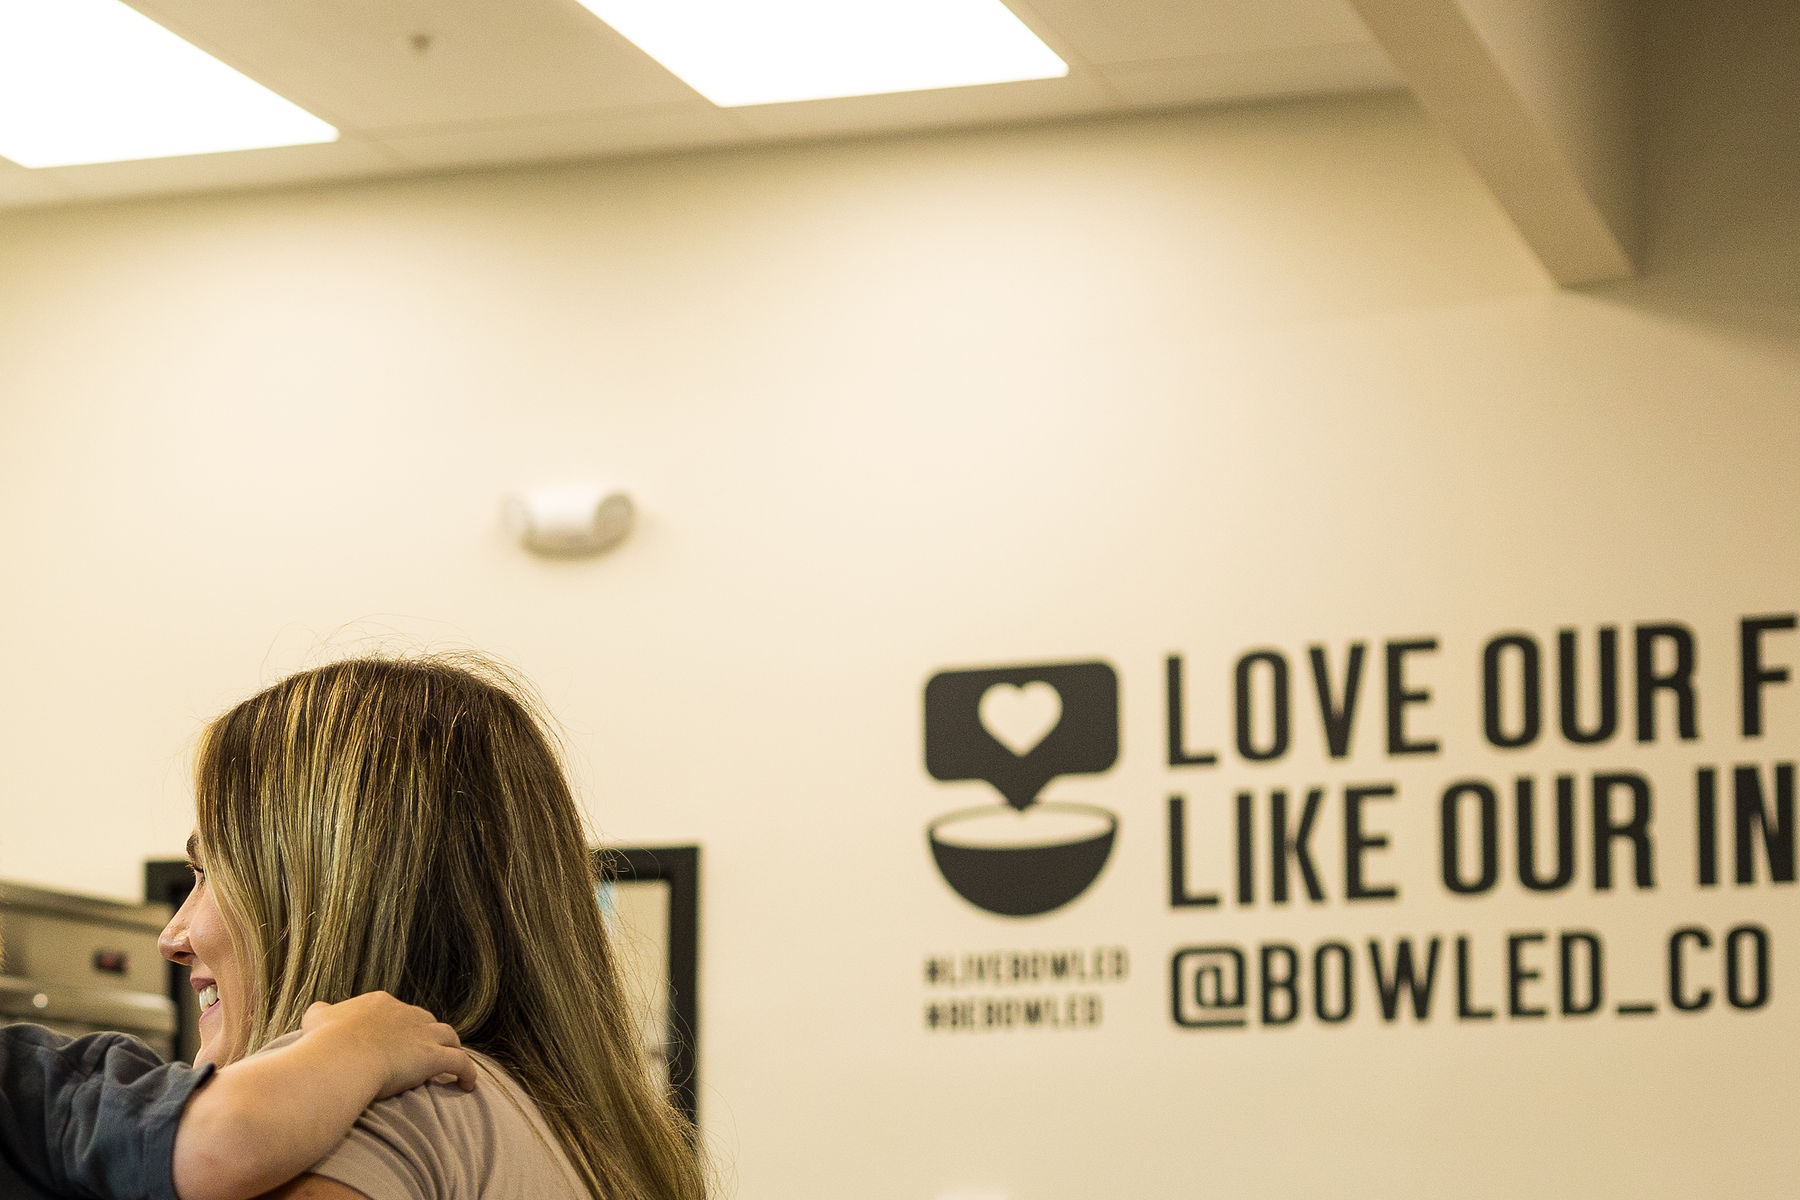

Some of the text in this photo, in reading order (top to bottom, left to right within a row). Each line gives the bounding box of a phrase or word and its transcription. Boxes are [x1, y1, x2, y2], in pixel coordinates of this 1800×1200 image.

[1166, 637, 1440, 766] LOVE
[1484, 623, 1700, 750] OUR
[1169, 784, 1398, 908] LIKE
[1443, 771, 1657, 896] OUR
[1171, 924, 1772, 1031] @BOWLED_CO
